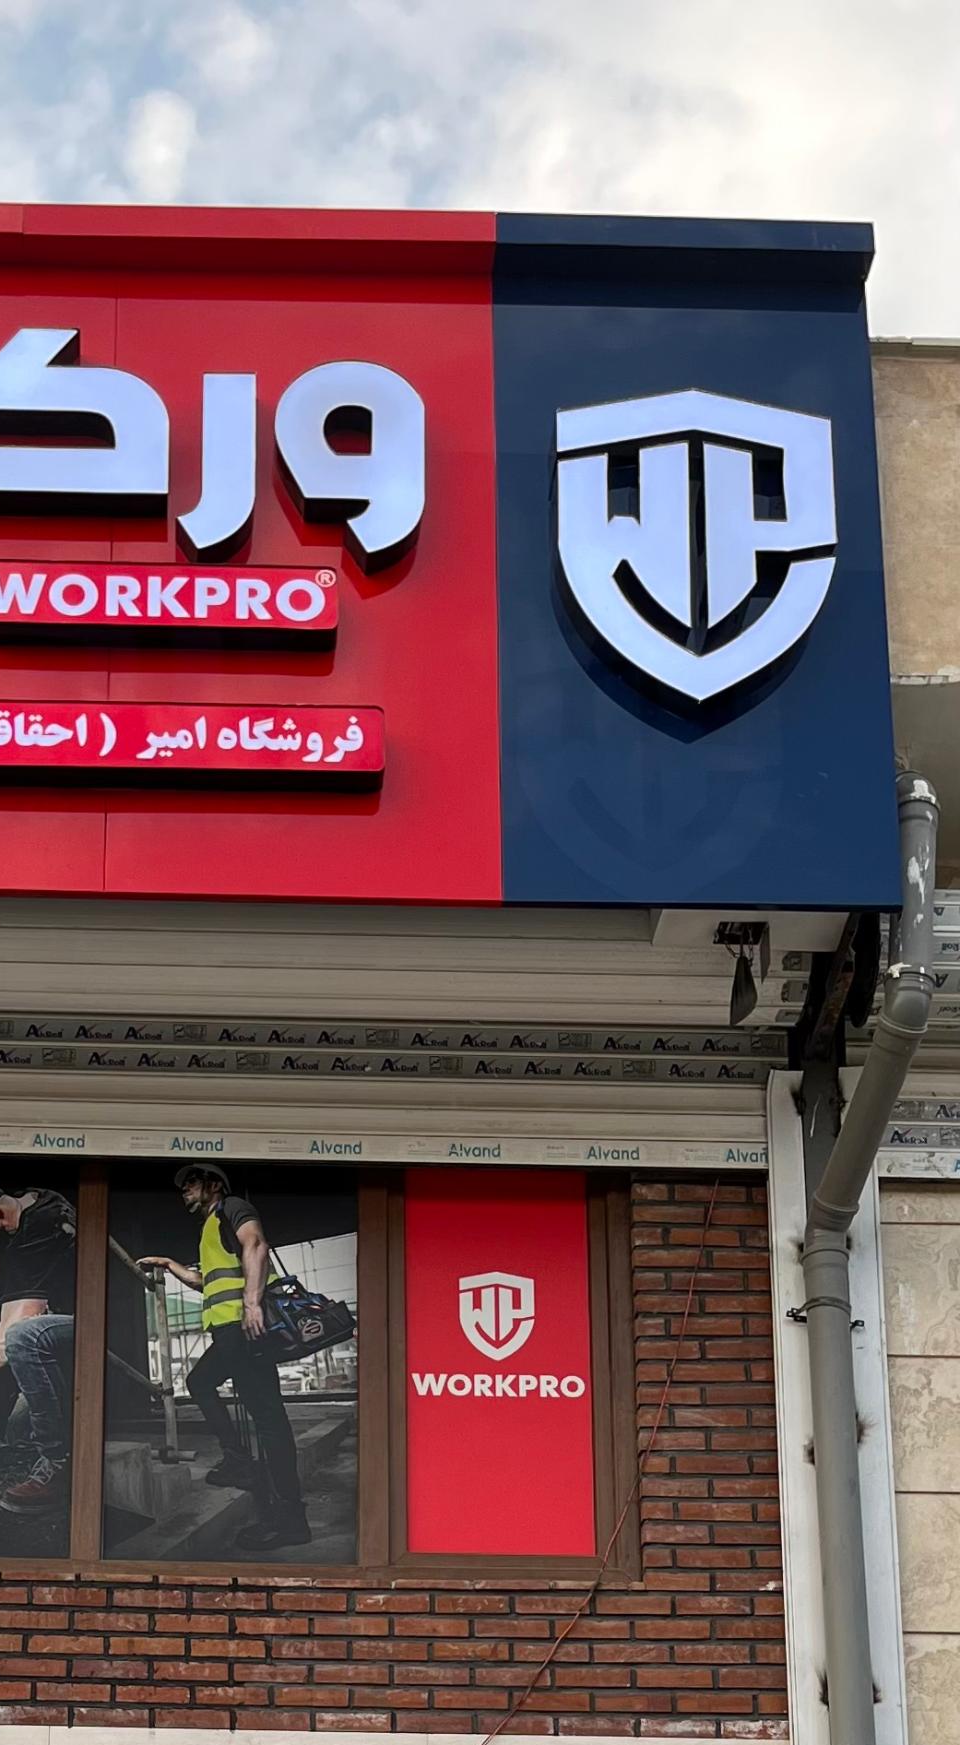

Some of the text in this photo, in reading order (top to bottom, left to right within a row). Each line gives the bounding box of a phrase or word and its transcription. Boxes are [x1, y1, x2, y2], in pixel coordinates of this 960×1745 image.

[136, 714, 207, 760] امیر
[216, 714, 364, 763] فروشگاه
[31, 1132, 86, 1149] Alvand
[170, 1136, 225, 1153] Alvand
[309, 1140, 363, 1156] Alvand
[586, 1146, 640, 1161] Alvand
[411, 1373, 586, 1398] WORKPRO
